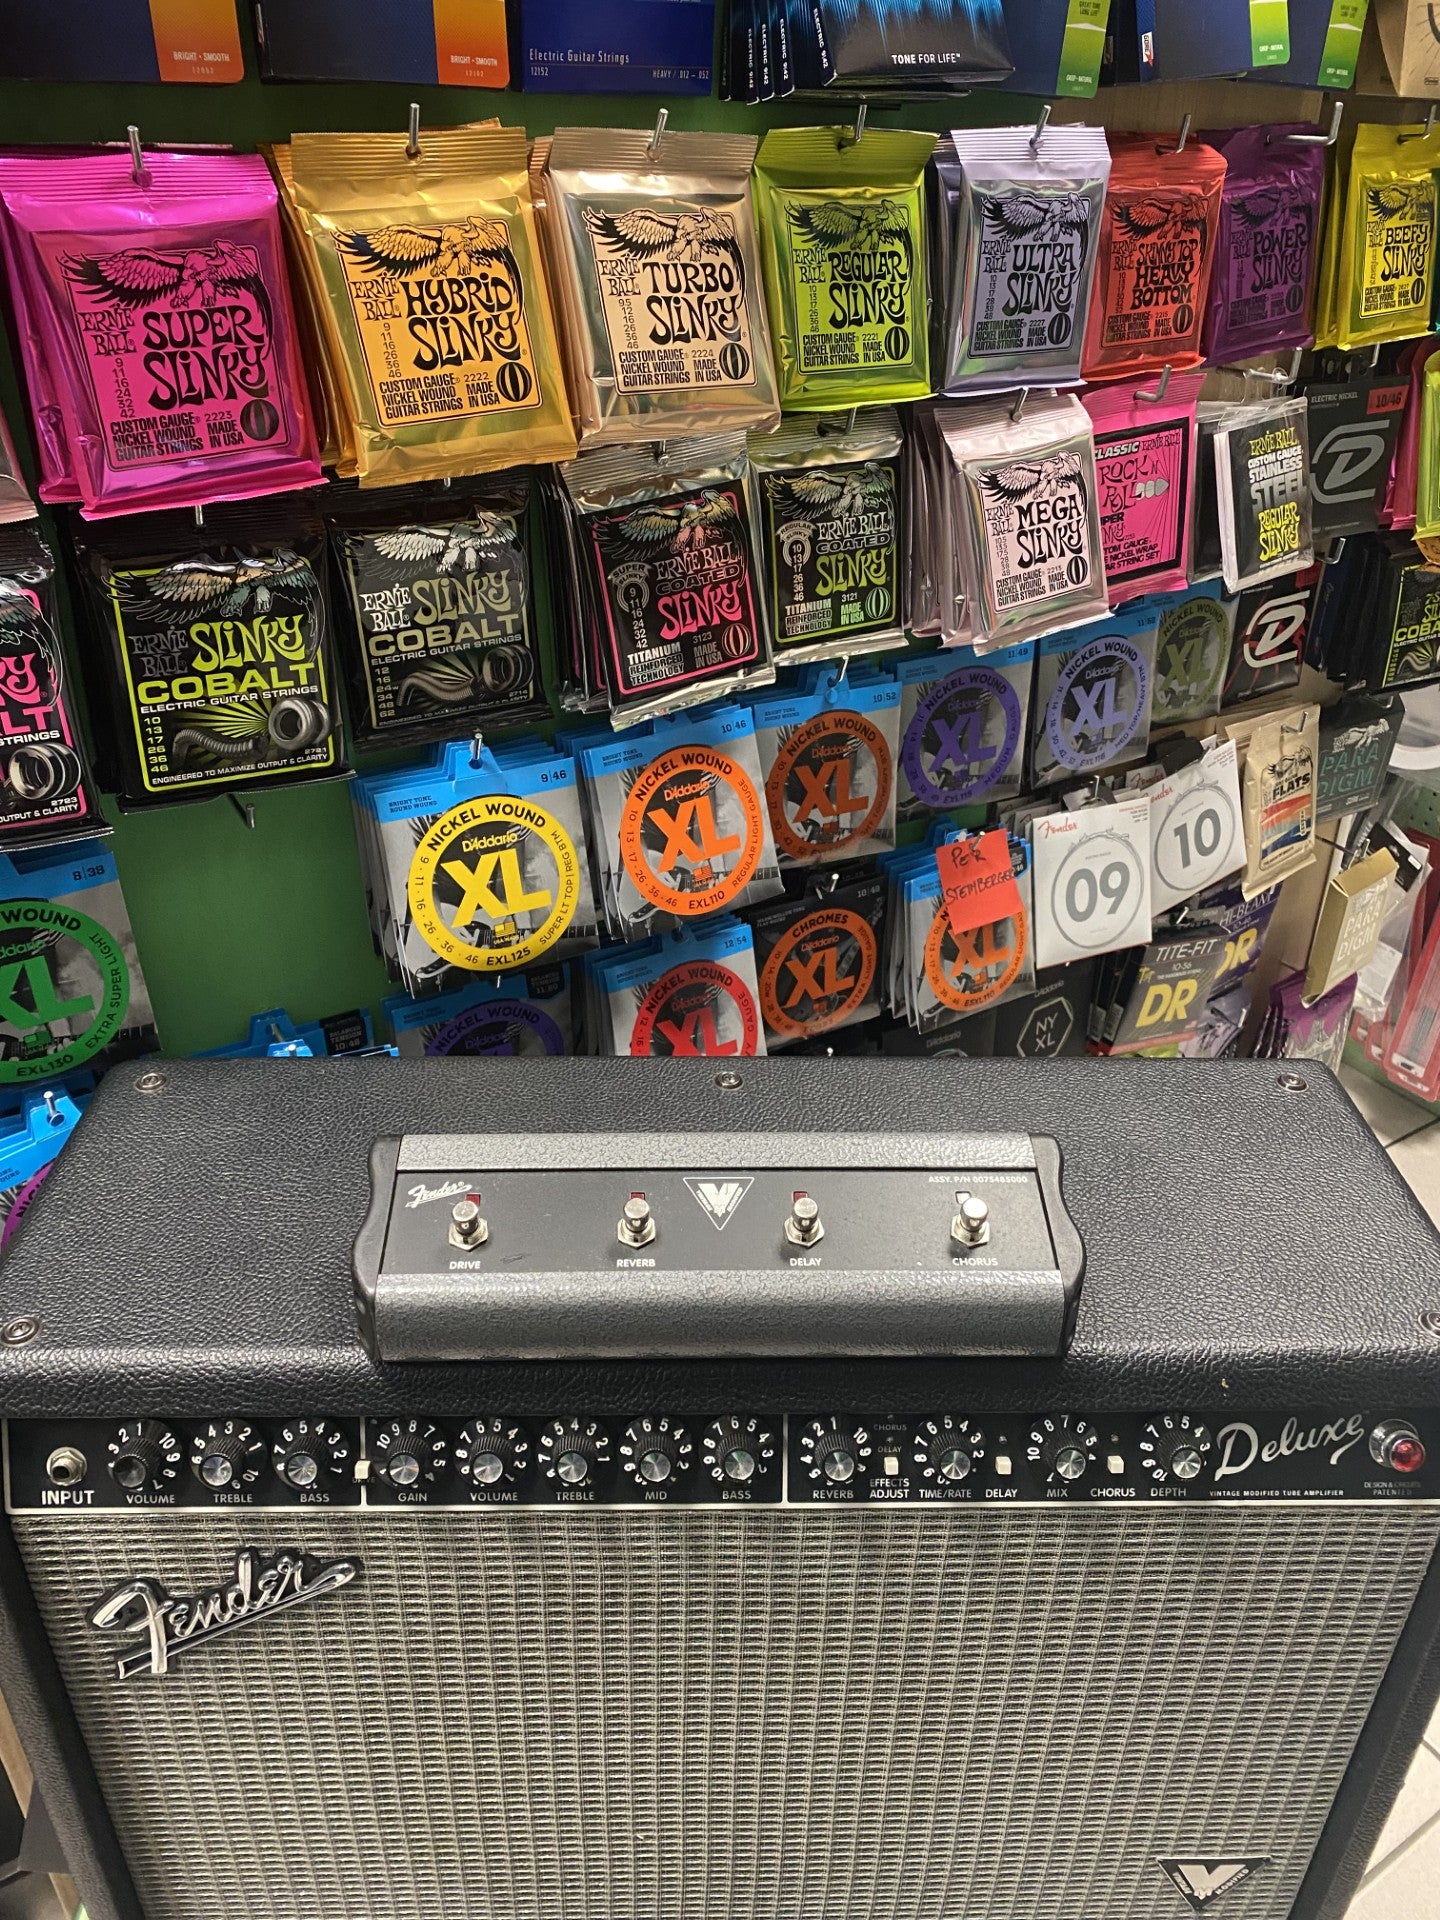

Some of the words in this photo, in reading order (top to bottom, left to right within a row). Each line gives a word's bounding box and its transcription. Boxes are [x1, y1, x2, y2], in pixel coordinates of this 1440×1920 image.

[173, 51, 197, 61] BRIGHT
[204, 52, 229, 62] SMOOTH
[530, 49, 564, 62] Electric
[568, 50, 594, 63] Guitar
[598, 51, 629, 64] Strings
[892, 54, 916, 64] TONE
[919, 54, 935, 63] FOR
[531, 67, 548, 76] 12152
[653, 70, 671, 78] HEAVY
[1253, 224, 1306, 255] POWER
[1385, 224, 1428, 245] BEEFY
[596, 252, 640, 276] ERNIE
[1013, 243, 1076, 273] ULTRA
[1137, 242, 1174, 267] SKINNY
[1177, 239, 1199, 263] TOP
[1381, 244, 1429, 282] SLINKY
[642, 261, 733, 294] TURBO
[828, 250, 908, 282] REGULAR
[1135, 262, 1194, 287] HEAVY
[1251, 250, 1303, 293] SLINKY
[349, 272, 400, 299] ERNIE
[400, 272, 513, 318] HYBRID
[607, 276, 641, 296] BALL
[1002, 271, 1078, 316] SLINKY
[1130, 284, 1193, 310] BOTTOM
[362, 299, 401, 321] BALL
[829, 281, 906, 329] SLINKY
[77, 303, 135, 333] ERNIE
[142, 305, 264, 350] SUPER
[646, 294, 742, 345] SLINKY
[91, 332, 137, 356] BALL
[408, 312, 521, 371] SLINKY
[692, 350, 714, 358] 2224
[619, 351, 658, 364] CUSTOM
[658, 349, 684, 361] GAUGE
[143, 345, 269, 410] SLINKY
[379, 378, 423, 394] CUSTOM
[424, 373, 455, 388] GAUGE
[382, 392, 418, 407] NICKEL
[419, 386, 456, 403] WOUND
[385, 402, 421, 419] GUITAR
[423, 398, 463, 414] STRINGS
[110, 416, 158, 435] CUSTOM
[160, 412, 194, 429] GAUGE
[204, 411, 232, 422] 2223
[207, 420, 237, 435] MADE
[113, 431, 153, 448] NICKEL
[154, 425, 195, 443] WOUND
[210, 435, 221, 448] IN
[222, 433, 245, 447] USA
[1249, 430, 1274, 455] ERNIE
[1276, 427, 1298, 448] BALL
[115, 443, 155, 462] GUITAR
[157, 438, 203, 456] STRINGS
[1100, 455, 1148, 485] ROCK
[1250, 457, 1303, 483] STAINLESS
[1103, 482, 1141, 512] ROLL
[1251, 474, 1307, 507] STEEL
[1015, 494, 1081, 530] MEGA
[1259, 502, 1299, 532] REGULAR
[816, 533, 890, 554] COATED
[1016, 519, 1083, 569] SLINKY
[1260, 523, 1299, 561] SLINKY
[653, 547, 700, 581] ERNIE
[702, 542, 738, 570] BALL
[815, 547, 887, 596] SLINKY
[656, 565, 740, 595] COATED
[359, 583, 411, 611] ERNIE
[412, 569, 512, 625] SLINKY
[658, 580, 742, 639] SLINKY
[785, 599, 831, 615] TITANIUM
[371, 608, 411, 632] BALL
[128, 625, 189, 654] ERNIE
[190, 614, 305, 672] SLINKY
[369, 614, 519, 656] COBALT
[142, 653, 188, 678] BALL
[627, 642, 681, 665] TITANIUM
[1065, 646, 1101, 679] NICKEL
[1105, 642, 1137, 662] WOUND
[138, 662, 314, 704] COBALT
[926, 678, 965, 711] NICKEL
[969, 673, 1007, 695] WOUND
[140, 699, 205, 714] ELECTRIC
[211, 692, 258, 706] GUITAR
[262, 685, 318, 698] STRINGS
[1070, 677, 1127, 737] XL
[787, 720, 830, 757] NICKEL
[834, 718, 876, 742] WOUND
[928, 711, 997, 773] XL
[152, 772, 203, 785] ENGINEERED
[217, 763, 255, 775] MAXIMIZE
[258, 758, 287, 769] OUTPUT
[297, 753, 327, 763] CLARITY
[1322, 743, 1378, 776] PARA
[635, 758, 678, 802] NICKEL
[681, 753, 732, 775] WOUND
[1273, 773, 1310, 800] FLATS
[793, 759, 869, 823] XL
[428, 806, 480, 851] NICKEL
[485, 803, 546, 828] WOUND
[647, 795, 741, 873] XL
[1037, 817, 1079, 838] Fender
[1174, 808, 1221, 869] 10
[440, 848, 551, 928] XL
[689, 890, 725, 909] EXL110
[1066, 861, 1130, 922] 09
[0, 907, 81, 931] WOUND
[792, 913, 849, 938] CHROMES
[486, 947, 531, 966] EXL125
[1156, 939, 1218, 962] TITE-FIT
[780, 947, 856, 1009] XL
[1135, 979, 1197, 1028] DR
[1036, 1013, 1058, 1035] NY
[1035, 1033, 1055, 1052] XL
[17, 1054, 74, 1077] EXL130
[405, 1182, 472, 1208] Fender
[450, 1260, 481, 1270] DRIVE
[616, 1259, 655, 1268] REVERB
[790, 1257, 822, 1267] DELAY
[952, 1257, 998, 1267] CHORUS
[1215, 1414, 1365, 1482] Deluxe
[556, 1491, 595, 1500] TREBLE
[723, 1491, 751, 1500] BASS
[813, 1490, 854, 1499] REVERB
[869, 1490, 909, 1499] ADJUST
[870, 1479, 909, 1487] EFFECTS
[919, 1489, 972, 1499] TIME/RATE
[985, 1489, 1018, 1498] DELAY
[1047, 1489, 1068, 1497] MIX
[1090, 1488, 1136, 1497] CHORUS
[1150, 1488, 1187, 1497] DEPTH
[41, 1490, 95, 1505] INPUT
[126, 1494, 175, 1504] VOLUME
[213, 1493, 253, 1503] TREBLE
[300, 1493, 330, 1503] BASS
[398, 1492, 428, 1502] GAIN
[470, 1492, 518, 1501] VOLUME
[645, 1492, 667, 1500] MID
[91, 1551, 357, 1680] Fender
